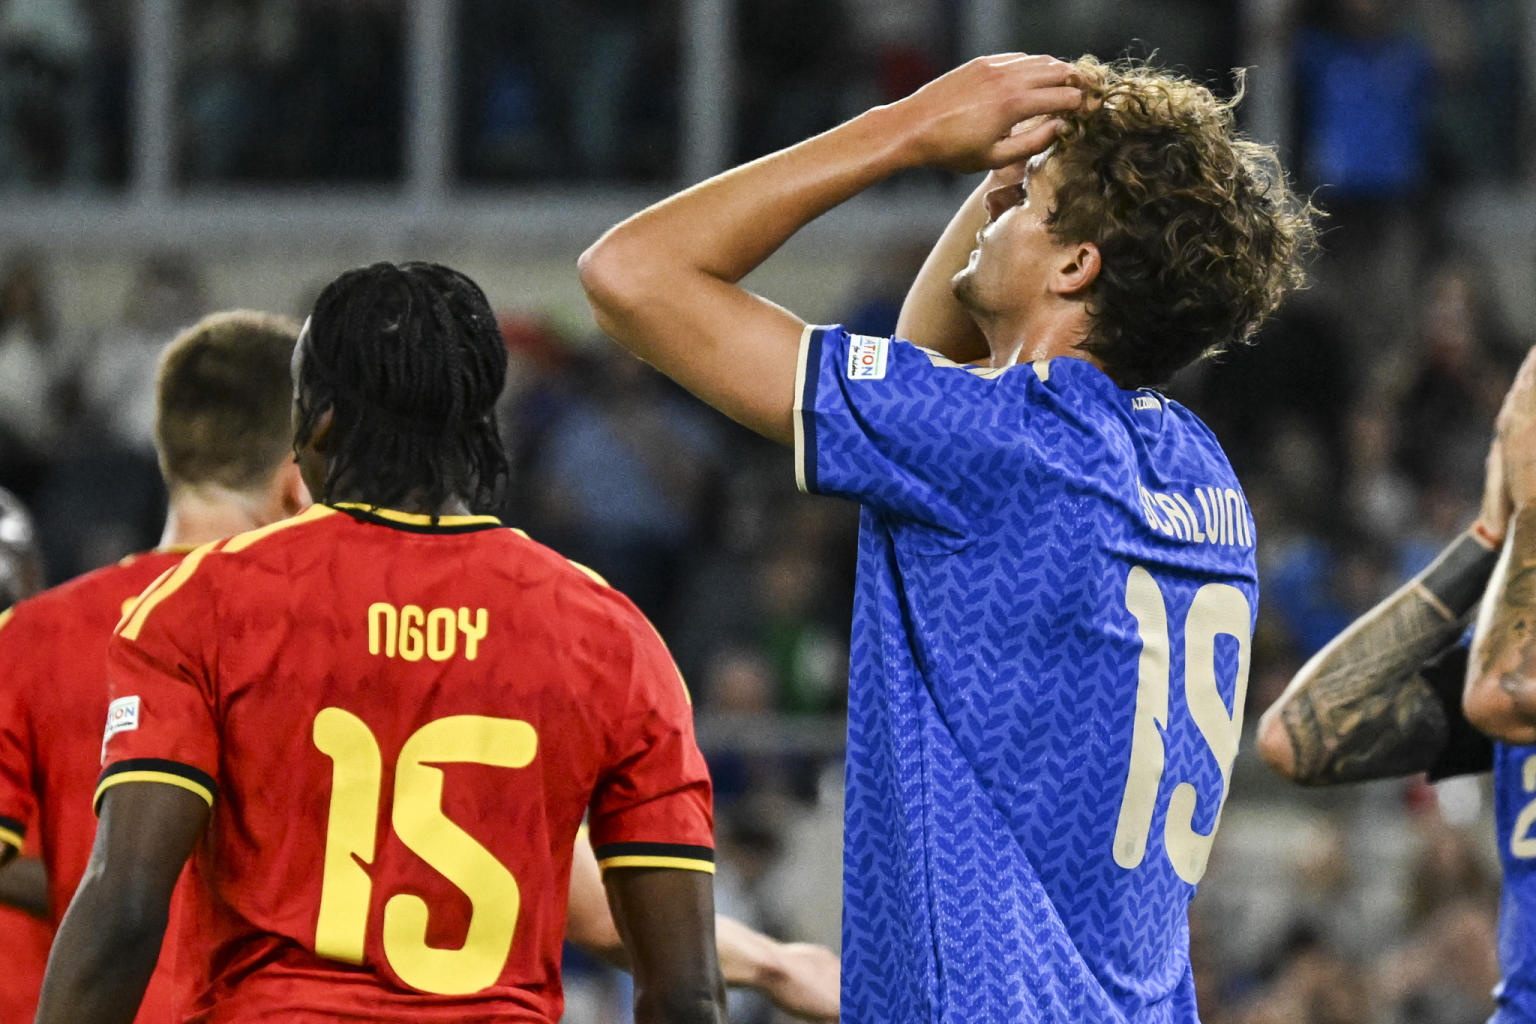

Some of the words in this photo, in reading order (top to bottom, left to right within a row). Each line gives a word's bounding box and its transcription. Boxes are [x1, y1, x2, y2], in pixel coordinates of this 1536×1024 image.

[367, 602, 488, 661] NGOY
[1112, 565, 1253, 885] 19
[312, 707, 538, 995] 15
